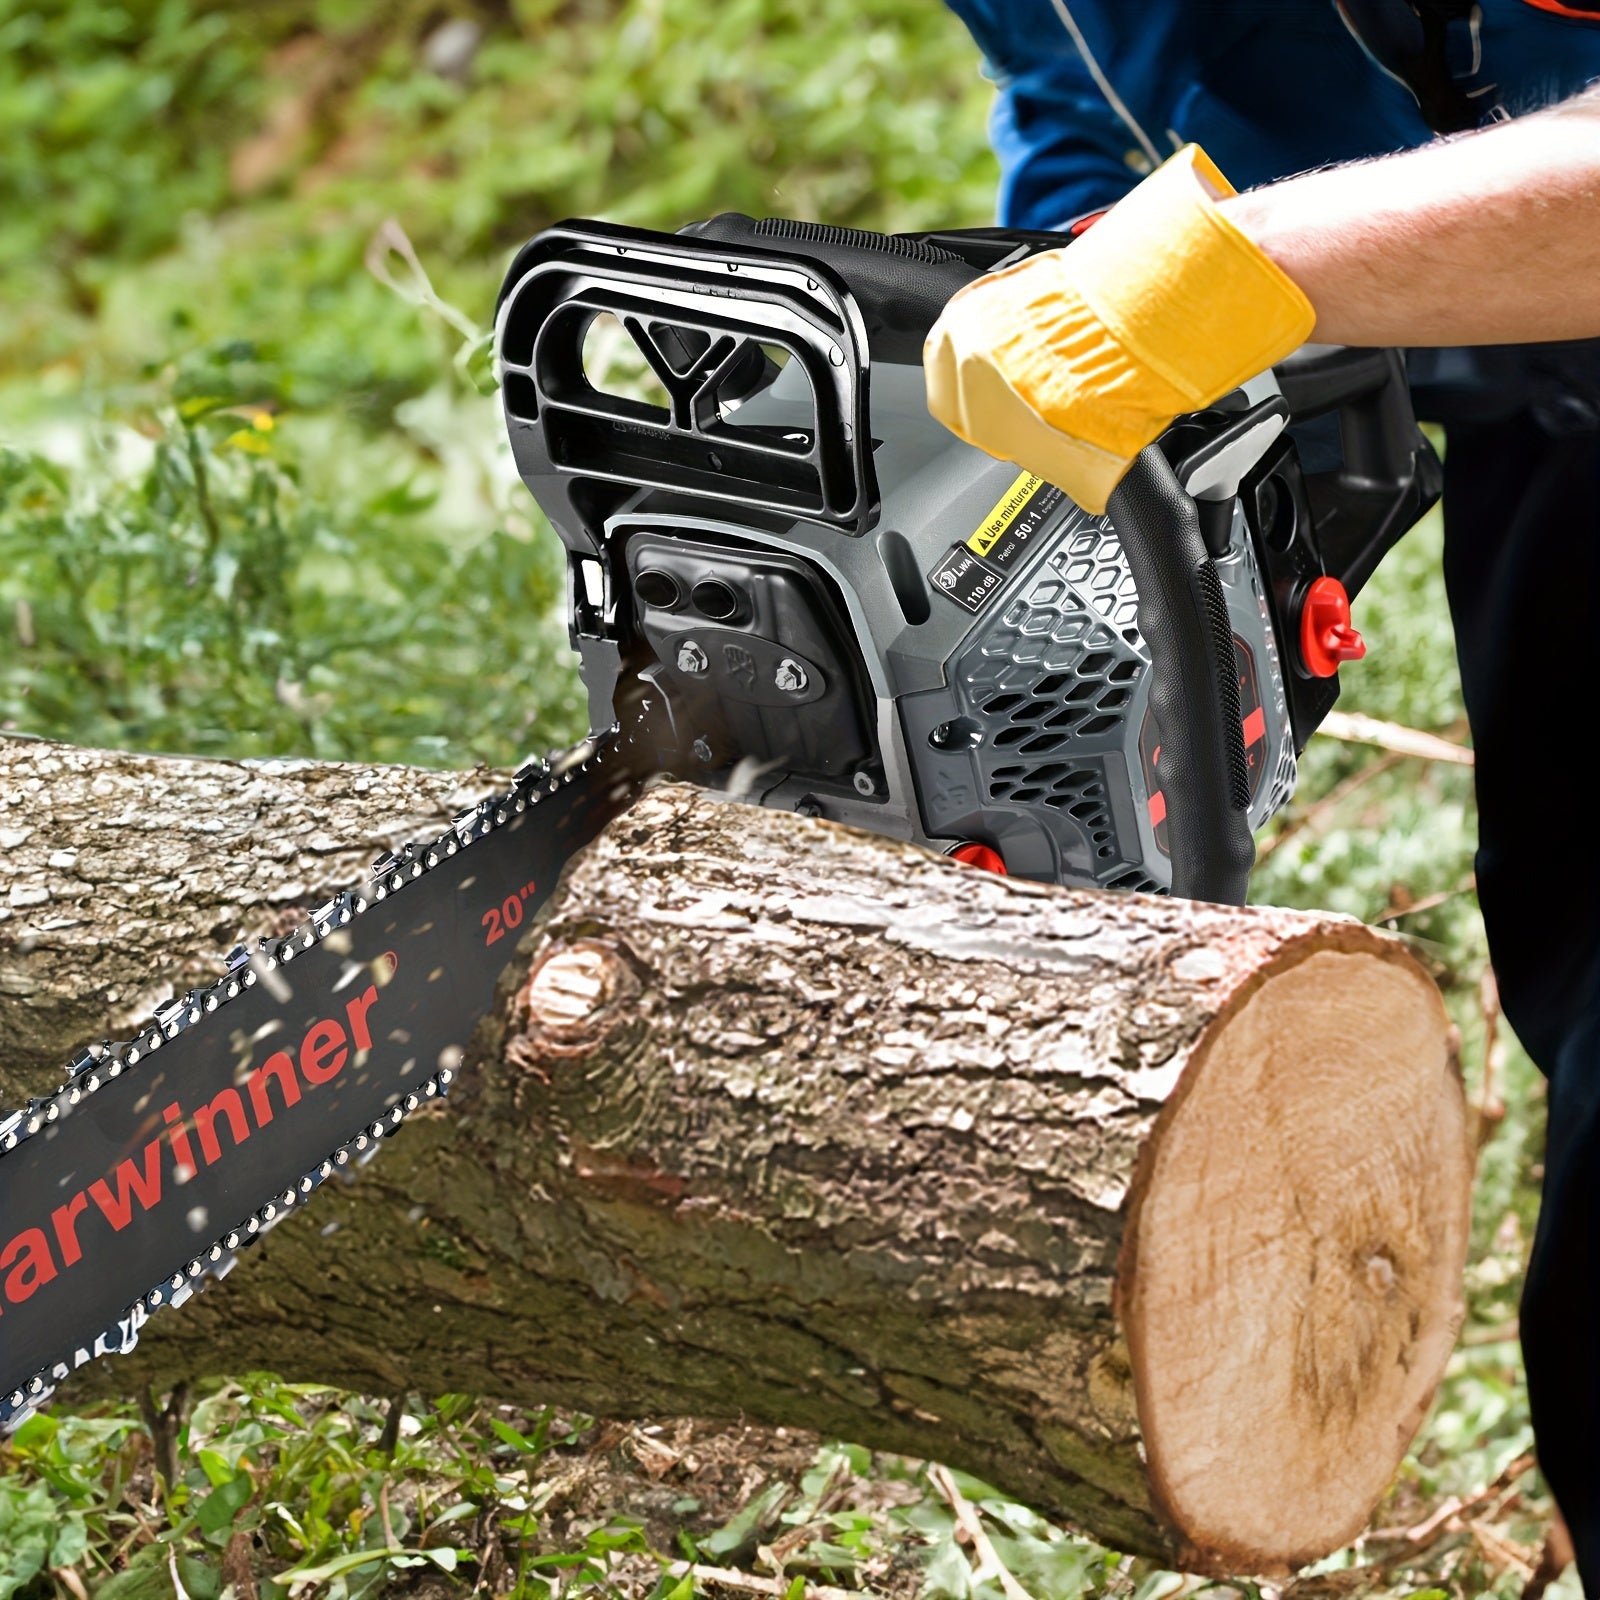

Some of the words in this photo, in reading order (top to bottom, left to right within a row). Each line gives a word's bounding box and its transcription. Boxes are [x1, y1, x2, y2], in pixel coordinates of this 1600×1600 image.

[984, 519, 1004, 538] Use
[1001, 487, 1029, 521] mixture
[997, 541, 1016, 562] Petrol
[1014, 511, 1042, 540] 50:1
[967, 586, 986, 604] 110
[983, 575, 996, 588] dB
[481, 880, 536, 947] 20"
[0, 984, 379, 1316] arwinner
